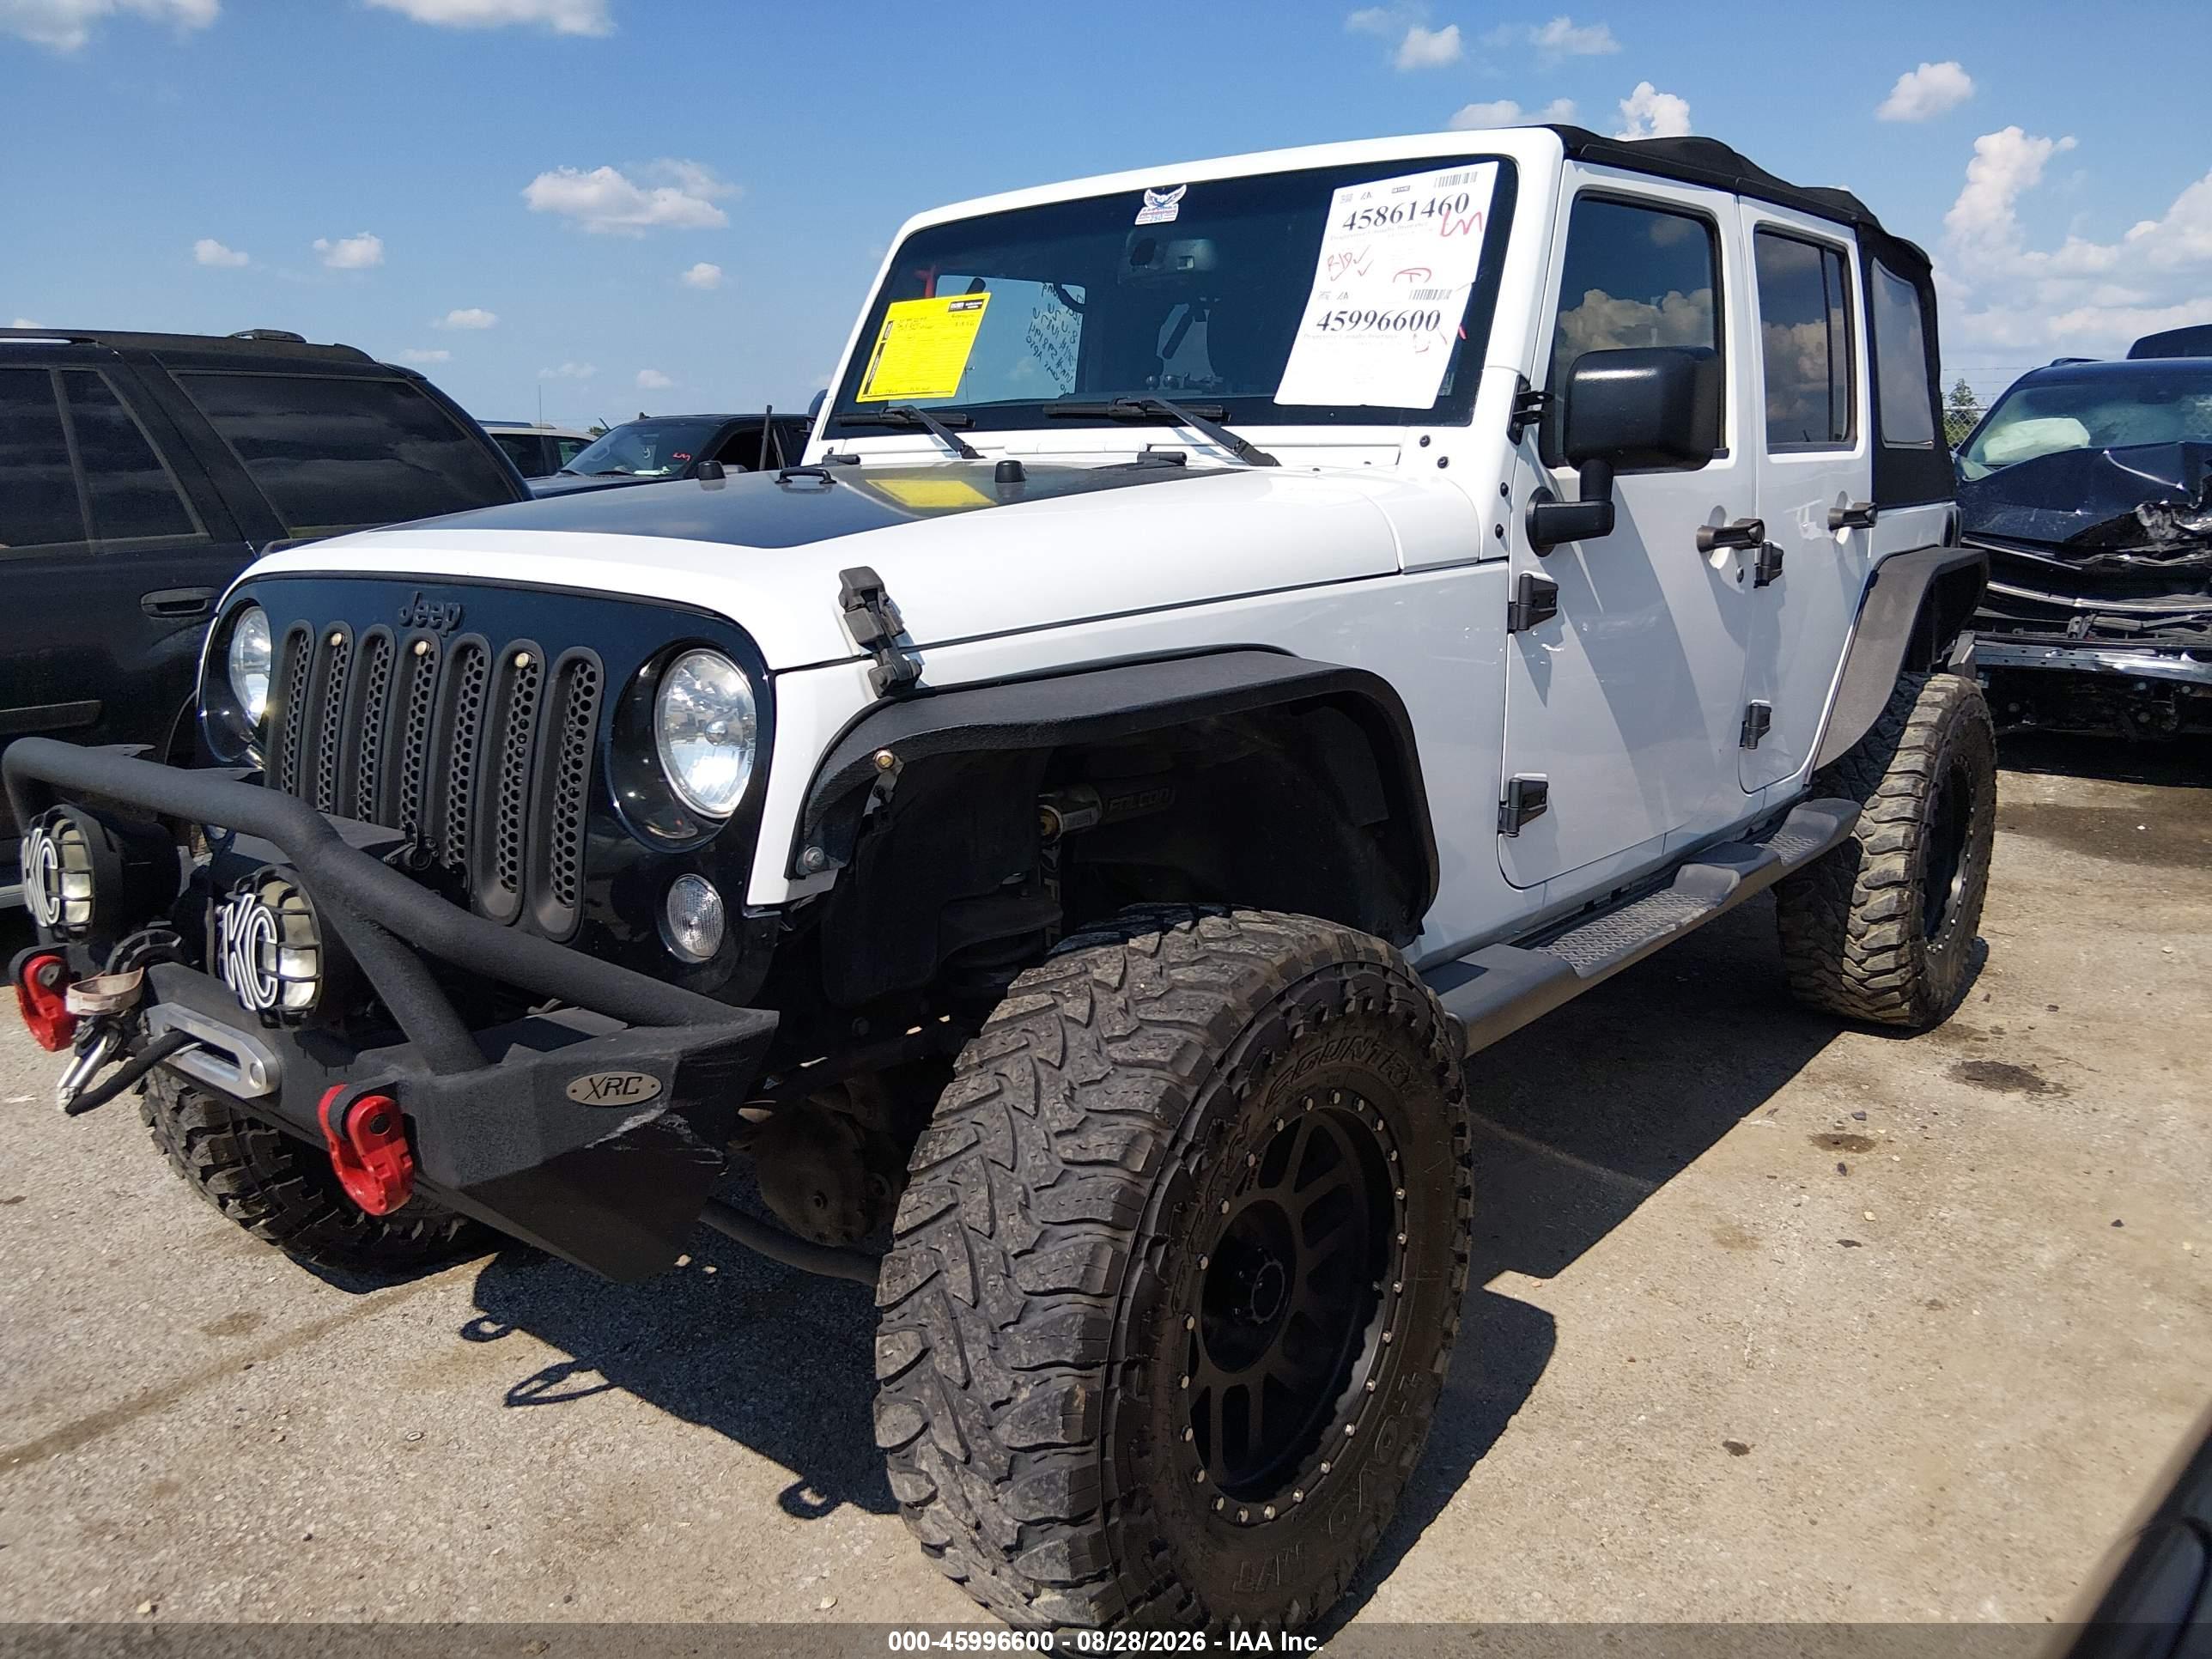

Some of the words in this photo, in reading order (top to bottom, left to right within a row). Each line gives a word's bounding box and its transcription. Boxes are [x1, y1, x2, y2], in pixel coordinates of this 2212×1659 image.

[1341, 192, 1471, 231] 45861460
[1316, 309, 1442, 332] 45996600
[398, 591, 465, 638] Jeep
[21, 827, 61, 927] KC
[217, 893, 279, 1012] KC
[582, 1076, 643, 1101] XRC
